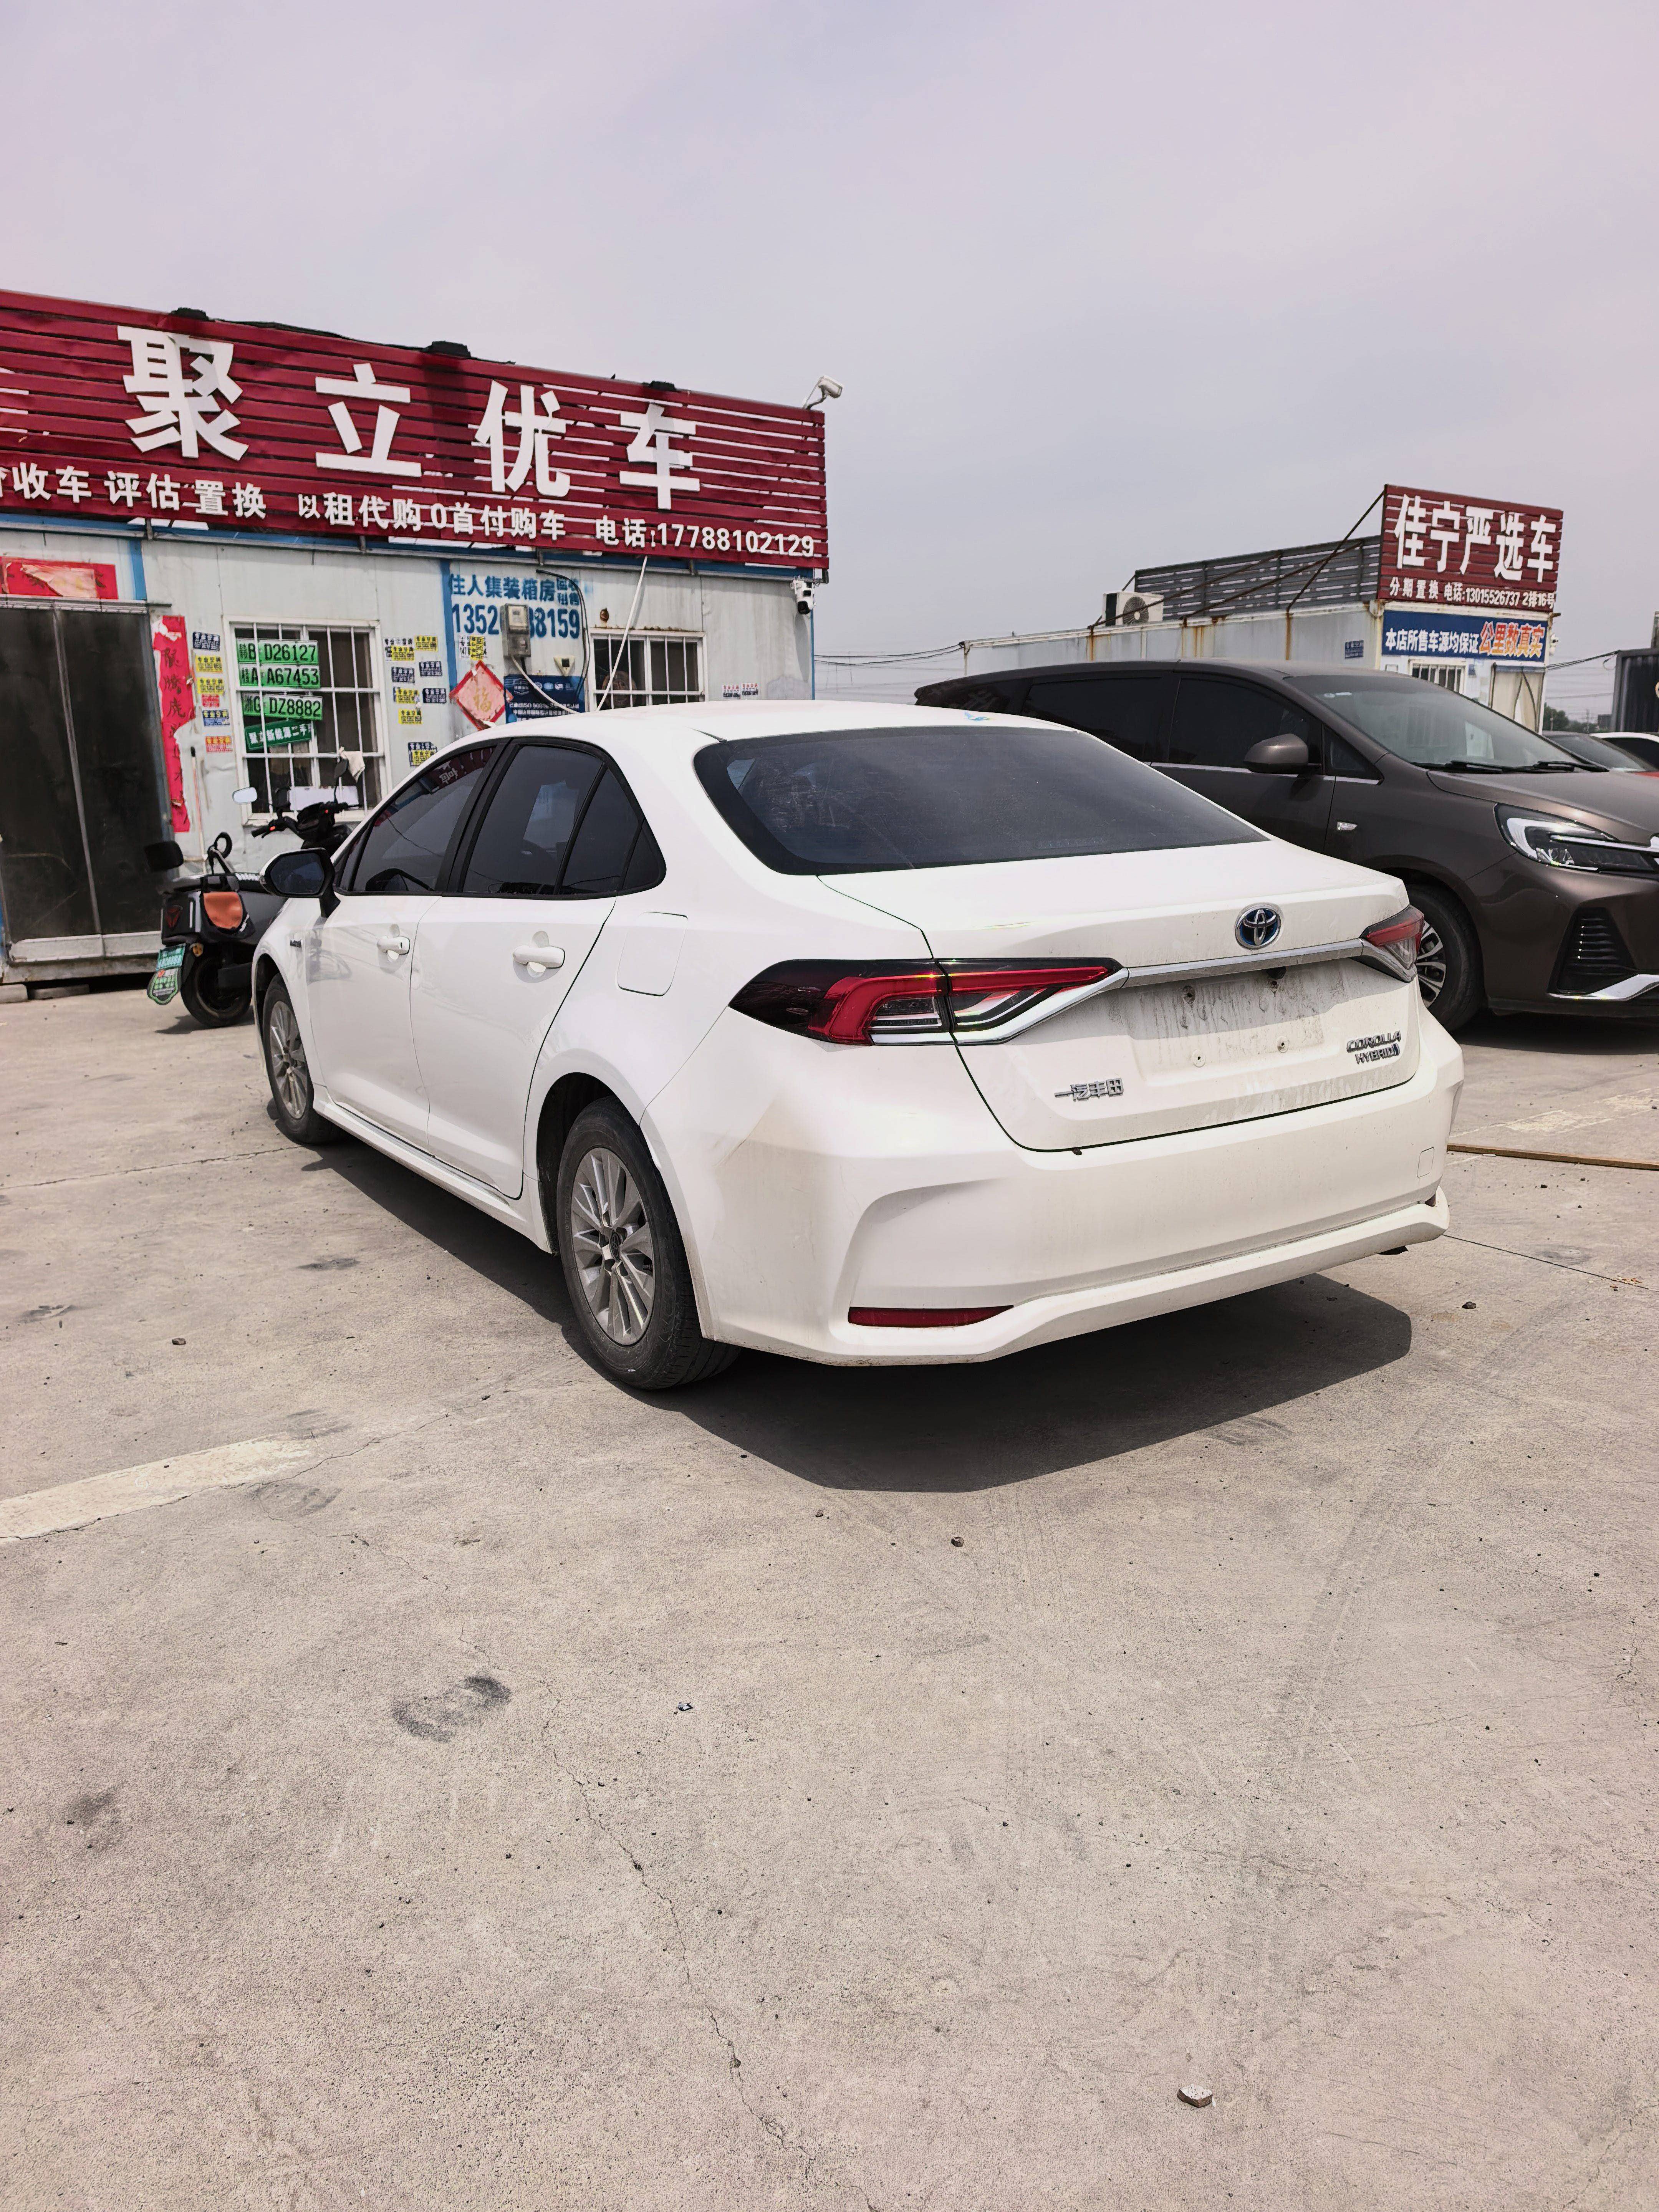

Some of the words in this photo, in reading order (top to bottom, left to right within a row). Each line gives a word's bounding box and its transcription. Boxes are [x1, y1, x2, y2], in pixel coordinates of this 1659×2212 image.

[117, 326, 700, 510] 聚立优车
[1394, 493, 1556, 583] 佳宁严选车
[1389, 576, 1439, 600] 分期置换
[1346, 1030, 1401, 1053] COROLLA
[1355, 1045, 1395, 1065] HYBRID
[1055, 1078, 1124, 1102] 一汽丰田
